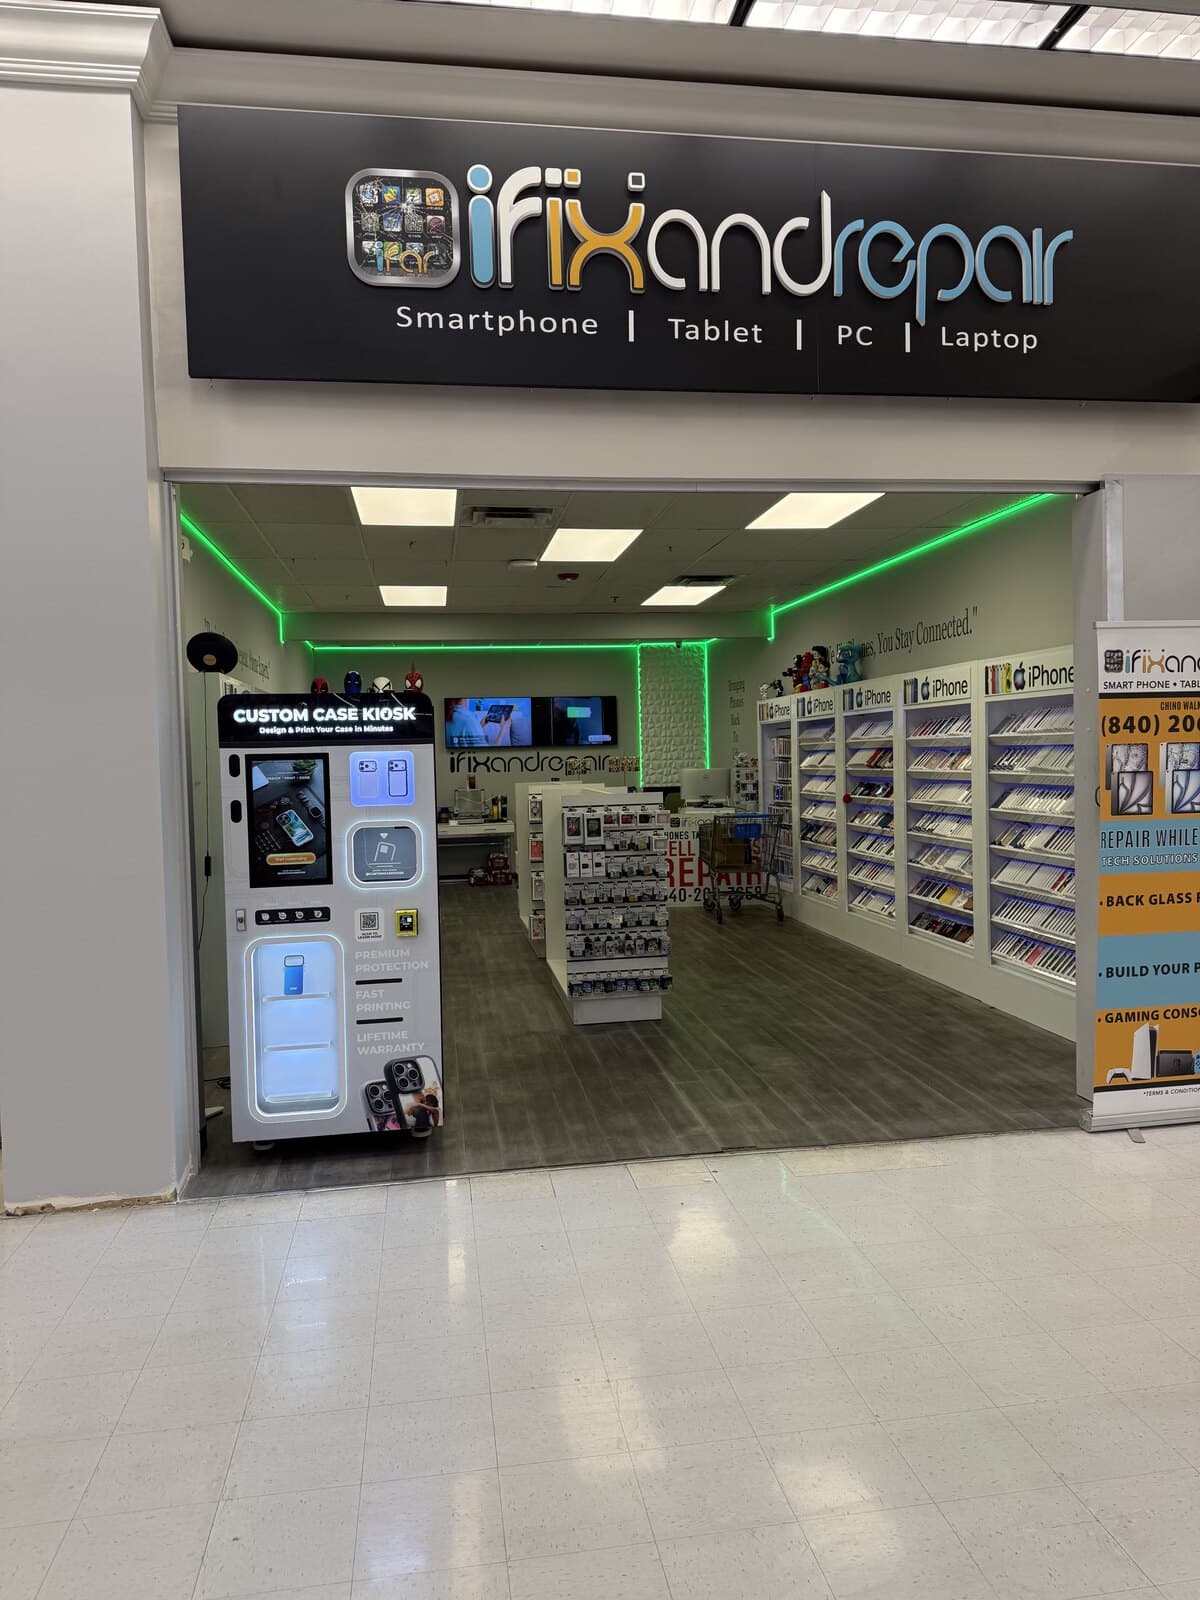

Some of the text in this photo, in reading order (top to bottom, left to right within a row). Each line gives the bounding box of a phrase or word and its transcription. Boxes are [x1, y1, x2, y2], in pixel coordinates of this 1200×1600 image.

[396, 306, 1038, 354] Smartphone Tablet PC Laptop
[877, 632, 893, 654] You
[895, 627, 915, 654] Stay
[1028, 665, 1074, 688] iPhone
[932, 679, 968, 697] iPhone
[1103, 681, 1133, 690] SMART
[1136, 680, 1170, 689] PHONE
[864, 689, 891, 706] iPhone
[813, 698, 833, 713] iPhone
[1160, 701, 1181, 711] CHINO
[233, 707, 416, 723] CUSTOM CASE KIOSK
[259, 727, 287, 735] Design
[363, 725, 393, 733] Minutes
[1101, 714, 1160, 737] (840)
[664, 831, 689, 840] HONES
[1101, 828, 1198, 849] REPAIR WHILE
[661, 841, 696, 857] ELL
[1102, 853, 1198, 867] TECH SOLUTIONS
[1106, 895, 1145, 907] BACK
[1149, 892, 1192, 905] GLASS
[355, 948, 410, 960] PREMIUM
[355, 961, 429, 973] PROTECTION
[1106, 966, 1149, 978] BUILD
[1152, 963, 1190, 976] YOUR
[356, 989, 384, 1000] FAST
[356, 1000, 411, 1012] PRINTING
[1104, 1010, 1159, 1024] GAMING
[357, 1030, 409, 1042] LIFETIME
[357, 1042, 424, 1055] WARRANTY
